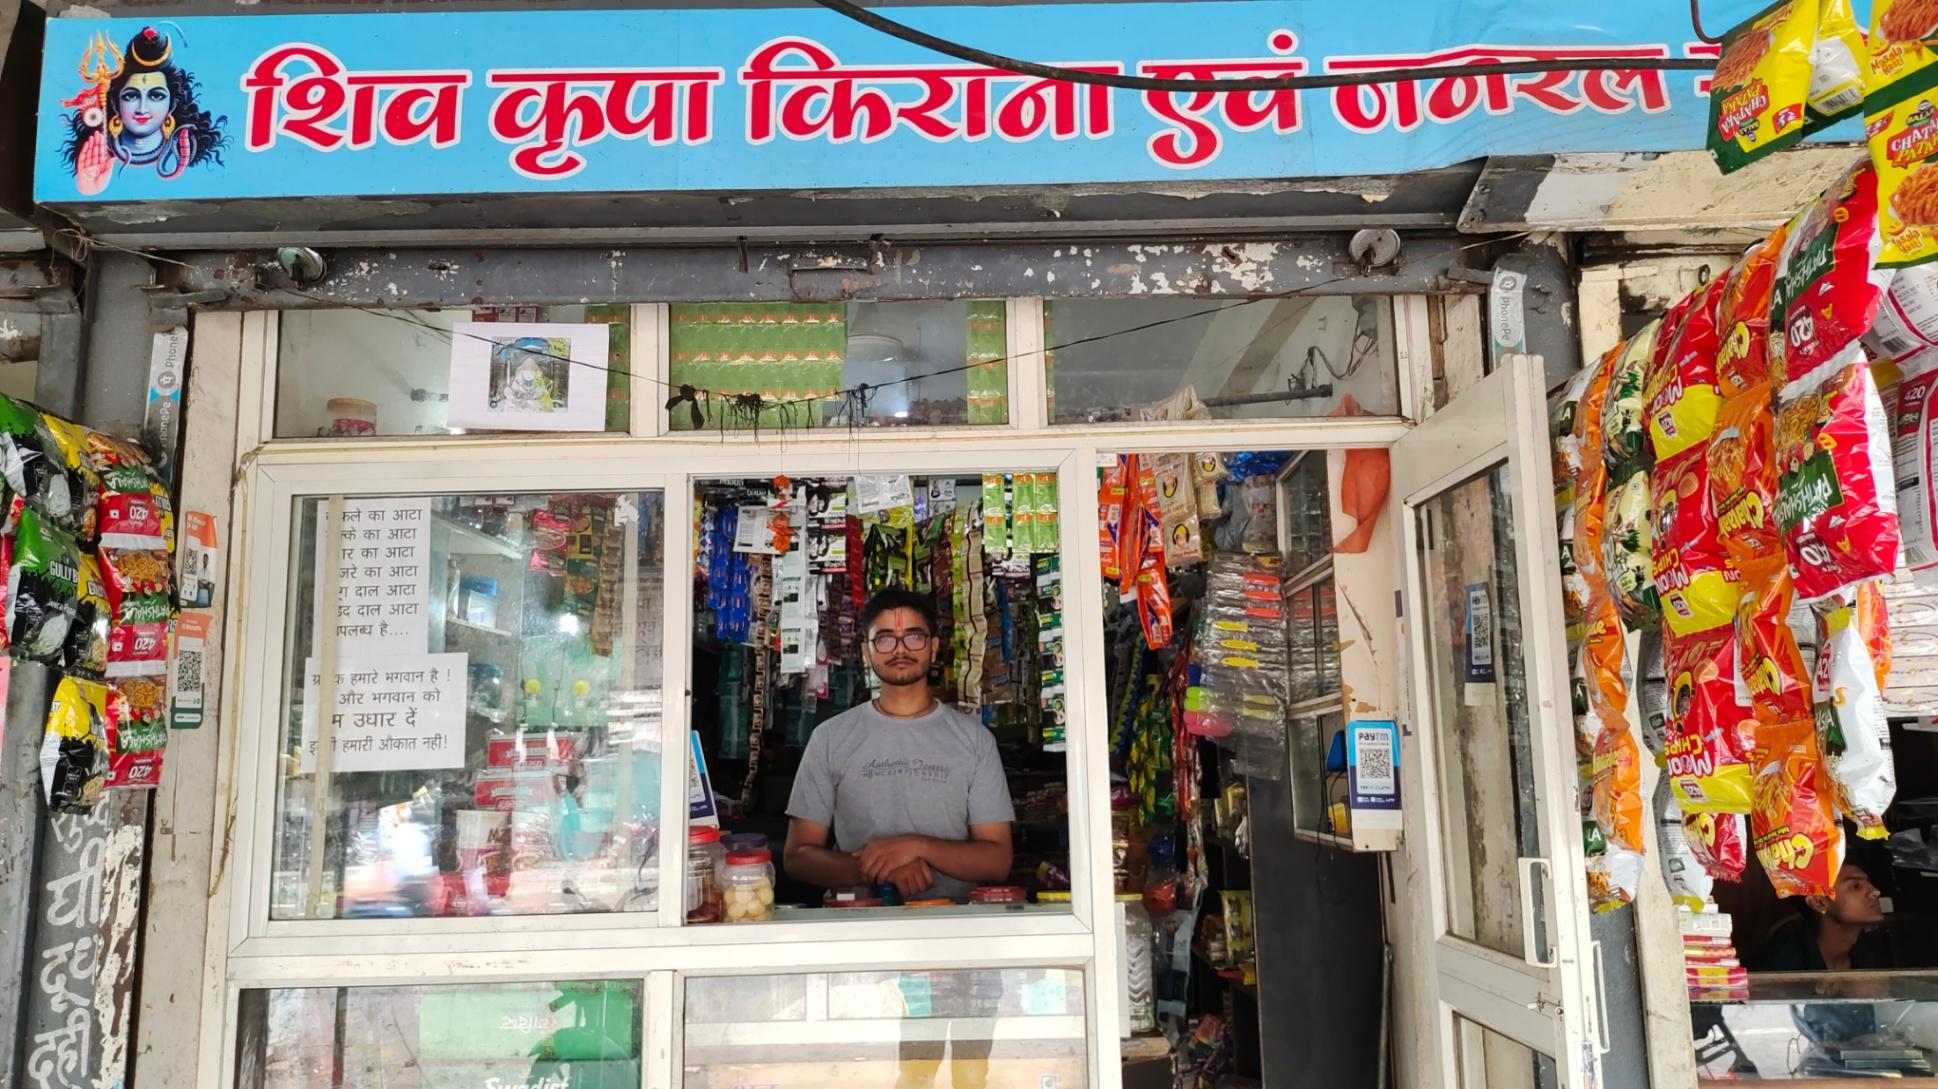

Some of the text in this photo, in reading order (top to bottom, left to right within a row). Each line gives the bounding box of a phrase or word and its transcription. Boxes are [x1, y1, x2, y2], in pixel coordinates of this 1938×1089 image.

[242, 43, 471, 150] शिव
[487, 67, 724, 178] कृपा
[738, 36, 1124, 146] किराना
[1138, 27, 1305, 169] एवं
[1720, 95, 1766, 133] CHATAKA
[1891, 117, 1938, 152] CHATA
[1790, 316, 1814, 347] 420
[164, 334, 178, 368] Phone
[129, 506, 149, 520] 420
[368, 510, 386, 521] का
[392, 508, 423, 521] आटा
[362, 528, 381, 541] का
[387, 527, 417, 540] आटा
[361, 547, 379, 559] का
[385, 545, 415, 558] आटा
[363, 565, 382, 578] का
[388, 564, 418, 577] आटा
[1652, 548, 1680, 576] CHIPS
[1655, 562, 1690, 595] MOON
[355, 584, 380, 598] दाल
[386, 583, 416, 596] आटा
[357, 603, 382, 617] दाल
[388, 602, 419, 615] आटा
[135, 637, 156, 650] 420
[350, 668, 378, 685] हमारे
[385, 670, 425, 684] भगवान
[429, 667, 439, 683] है
[372, 691, 416, 704] भगवान
[422, 687, 441, 702] को
[353, 711, 397, 728] उधार
[404, 706, 418, 728] दें
[342, 735, 373, 753] हमारी
[378, 734, 418, 751] औकात
[129, 765, 152, 779] 420
[1667, 750, 1713, 778] MOO
[46, 836, 106, 928] घी
